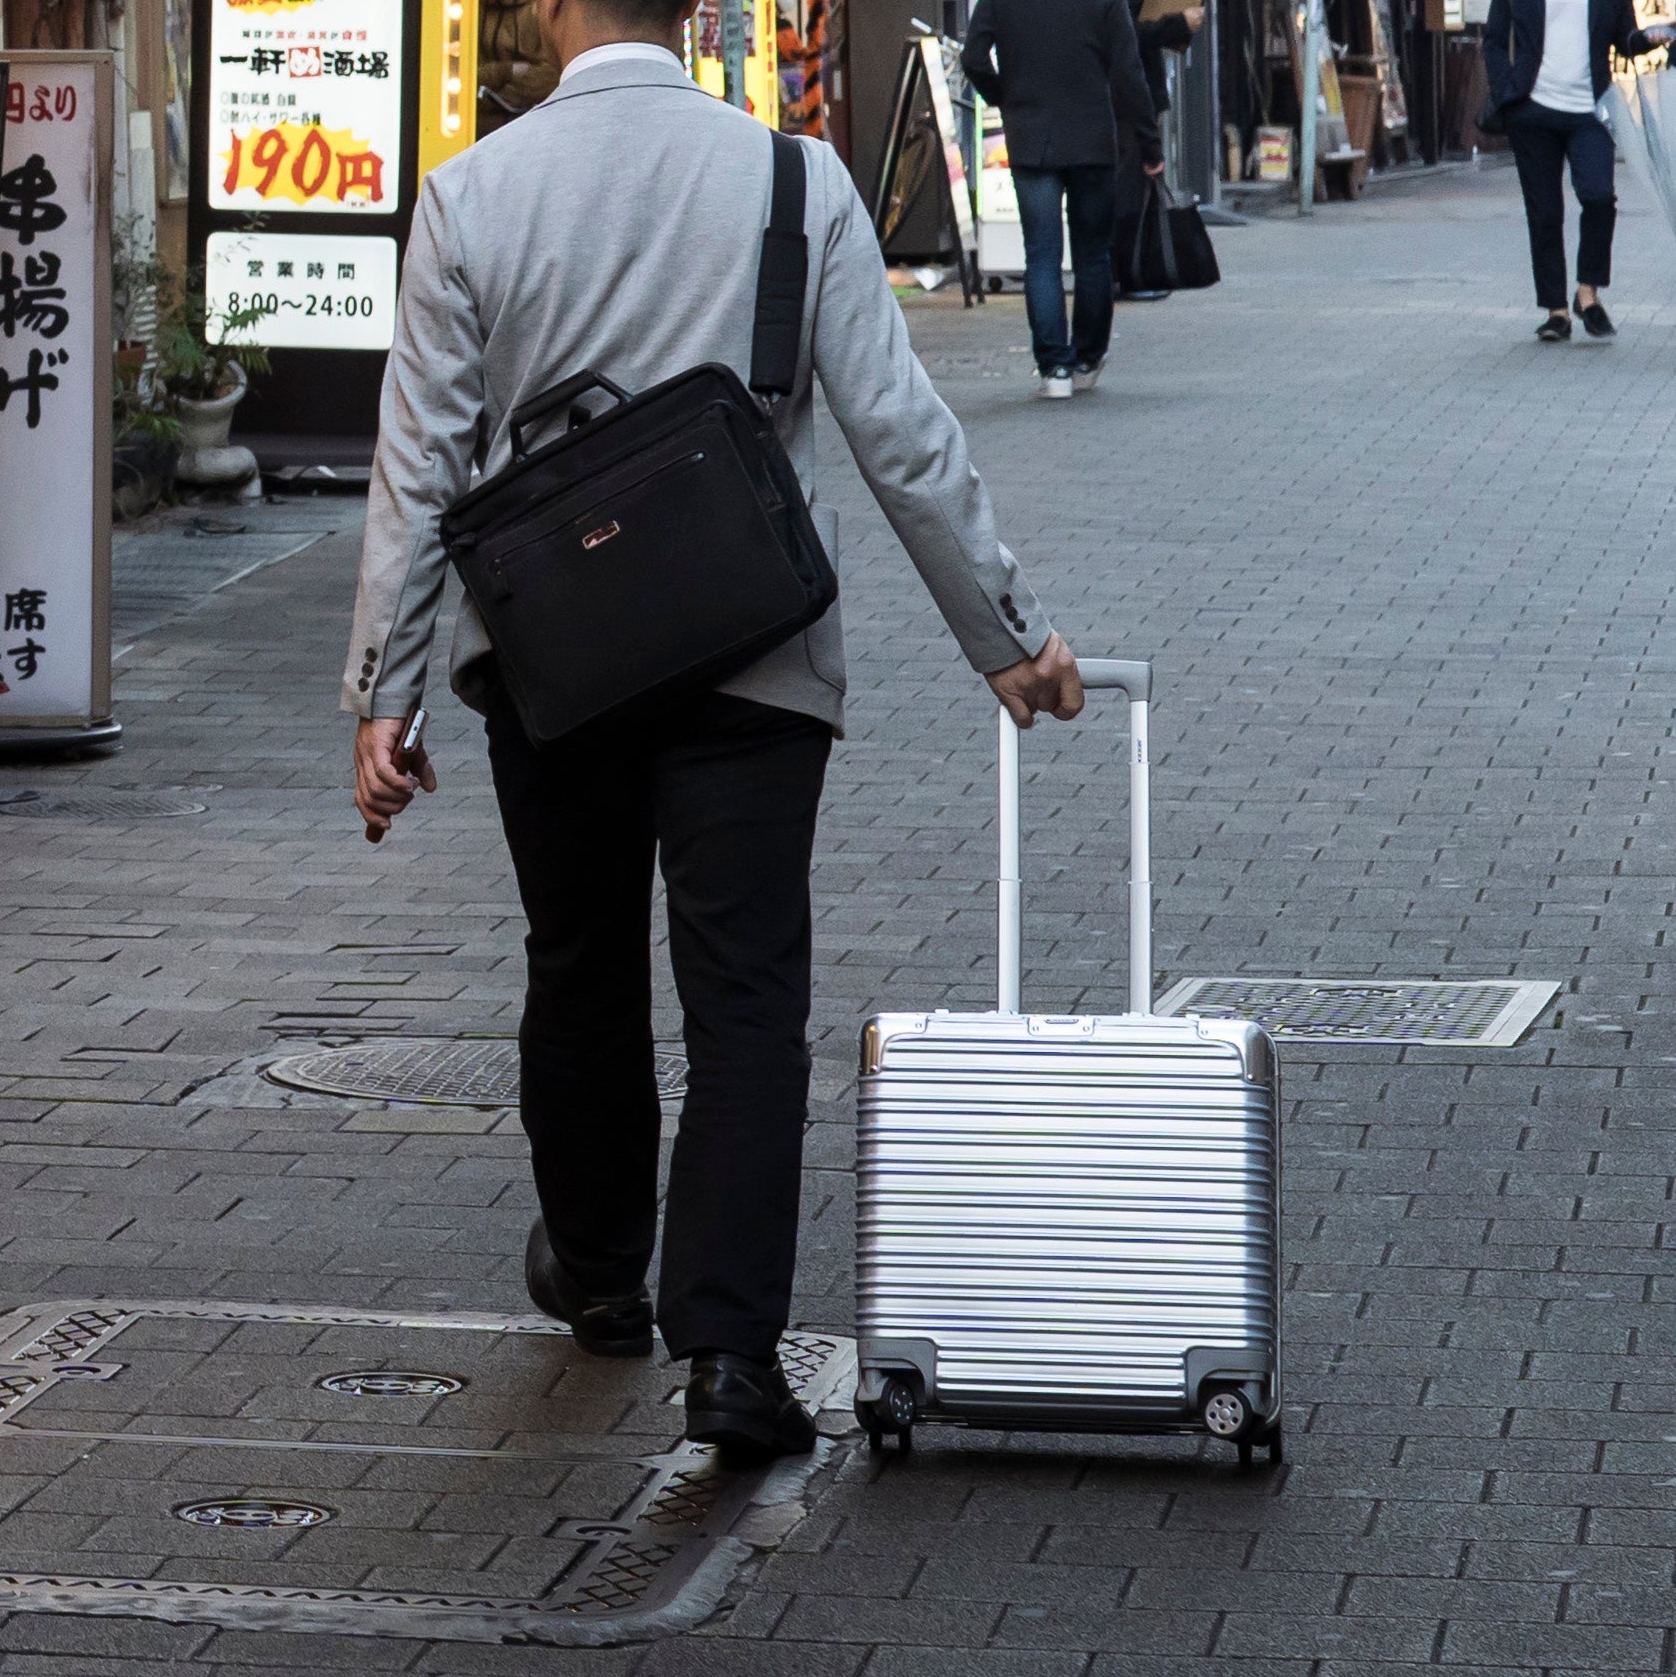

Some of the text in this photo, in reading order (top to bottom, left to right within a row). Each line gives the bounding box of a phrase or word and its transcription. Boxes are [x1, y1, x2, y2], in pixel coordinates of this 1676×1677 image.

[219, 46, 390, 79] 一軒め酒場
[223, 128, 384, 203] 190円
[247, 261, 357, 282] 営業時間
